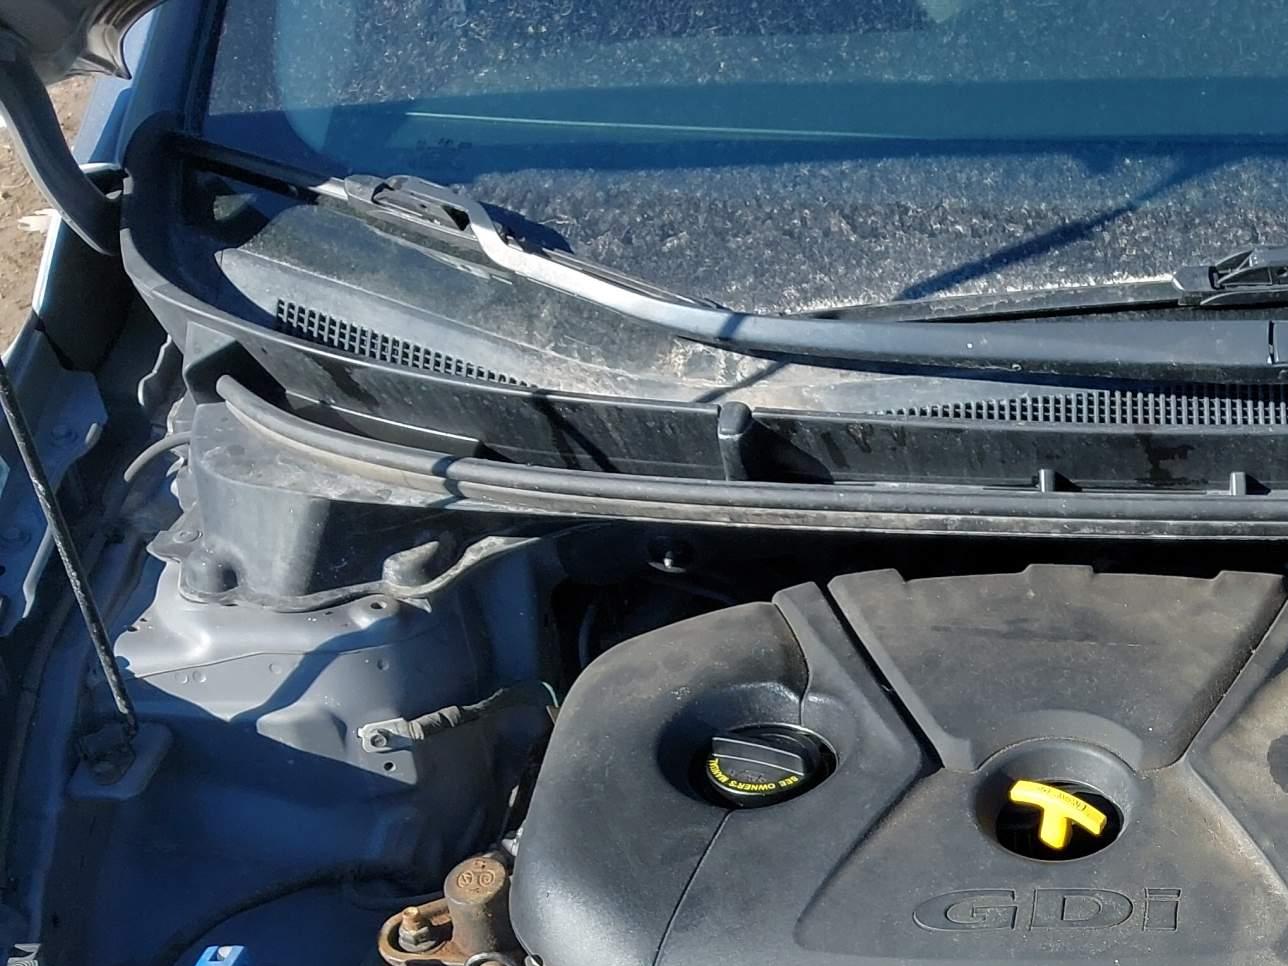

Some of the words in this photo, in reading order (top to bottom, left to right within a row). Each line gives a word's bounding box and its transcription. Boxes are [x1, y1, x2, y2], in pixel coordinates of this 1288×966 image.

[728, 780, 776, 792] OWNER'S
[778, 776, 799, 787] SEE
[912, 887, 1182, 931] GDi
